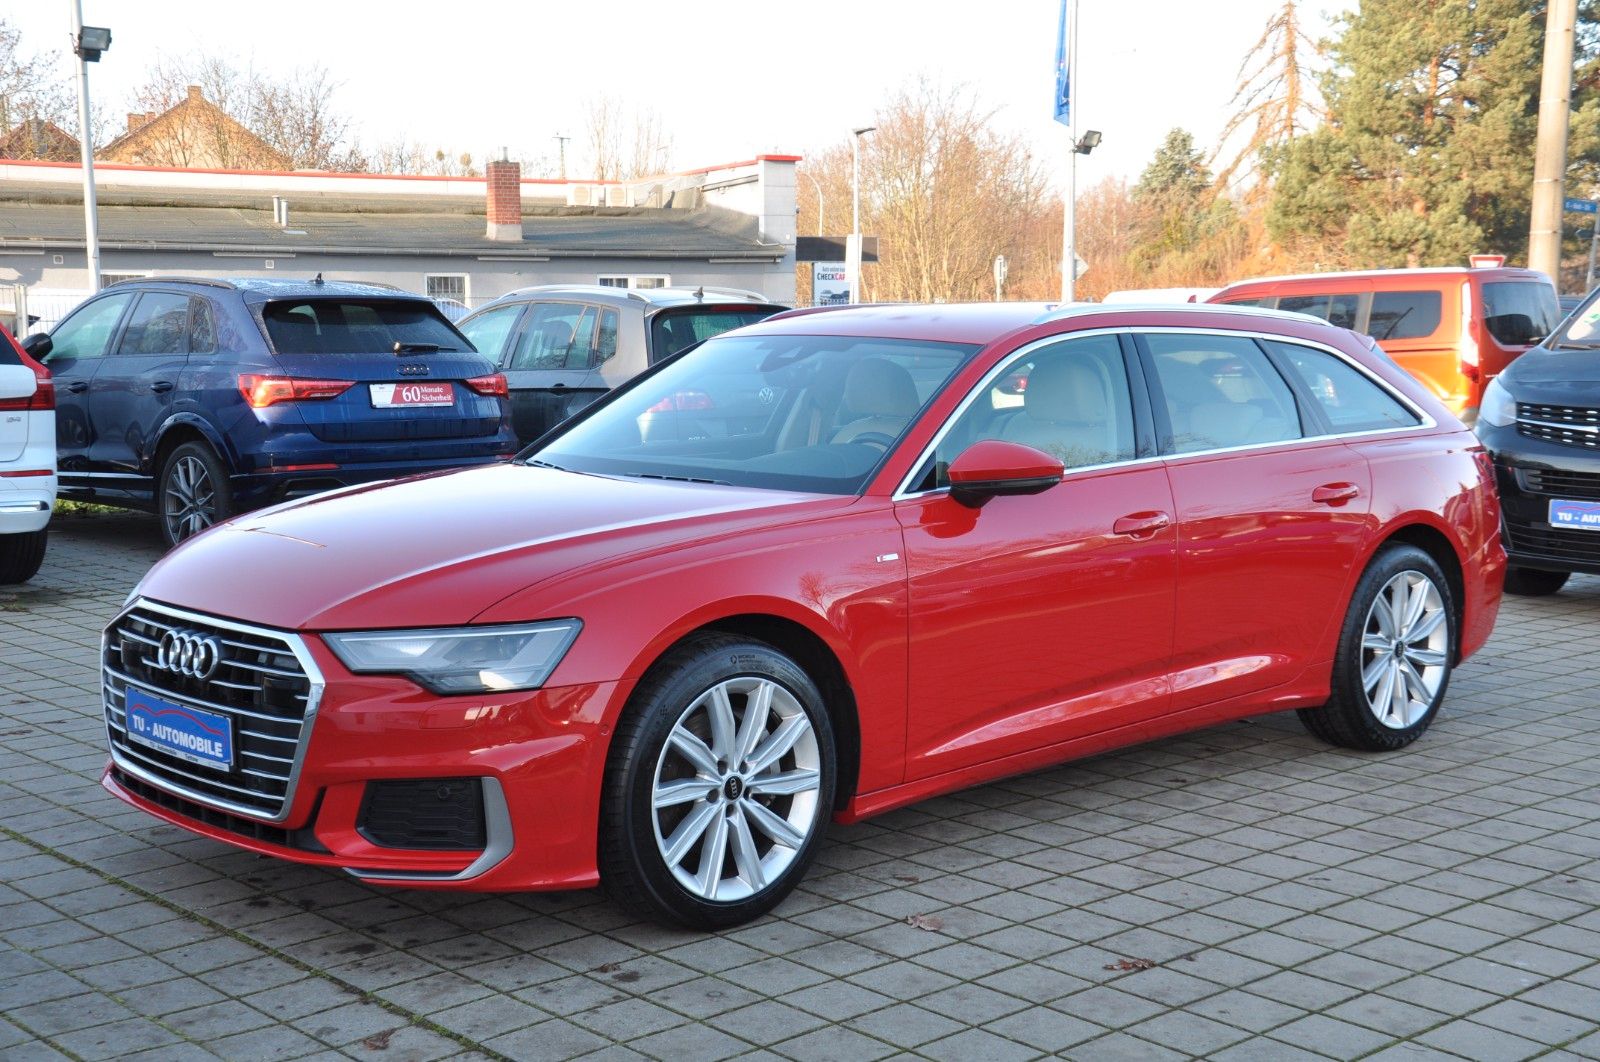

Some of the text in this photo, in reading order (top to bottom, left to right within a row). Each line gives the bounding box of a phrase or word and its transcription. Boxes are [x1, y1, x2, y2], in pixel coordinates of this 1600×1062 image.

[402, 386, 421, 402] 60
[421, 393, 452, 401] Sicherheit
[1557, 512, 1572, 521] TU
[132, 714, 145, 732] TU
[152, 722, 224, 758] AUTOMOBILE
